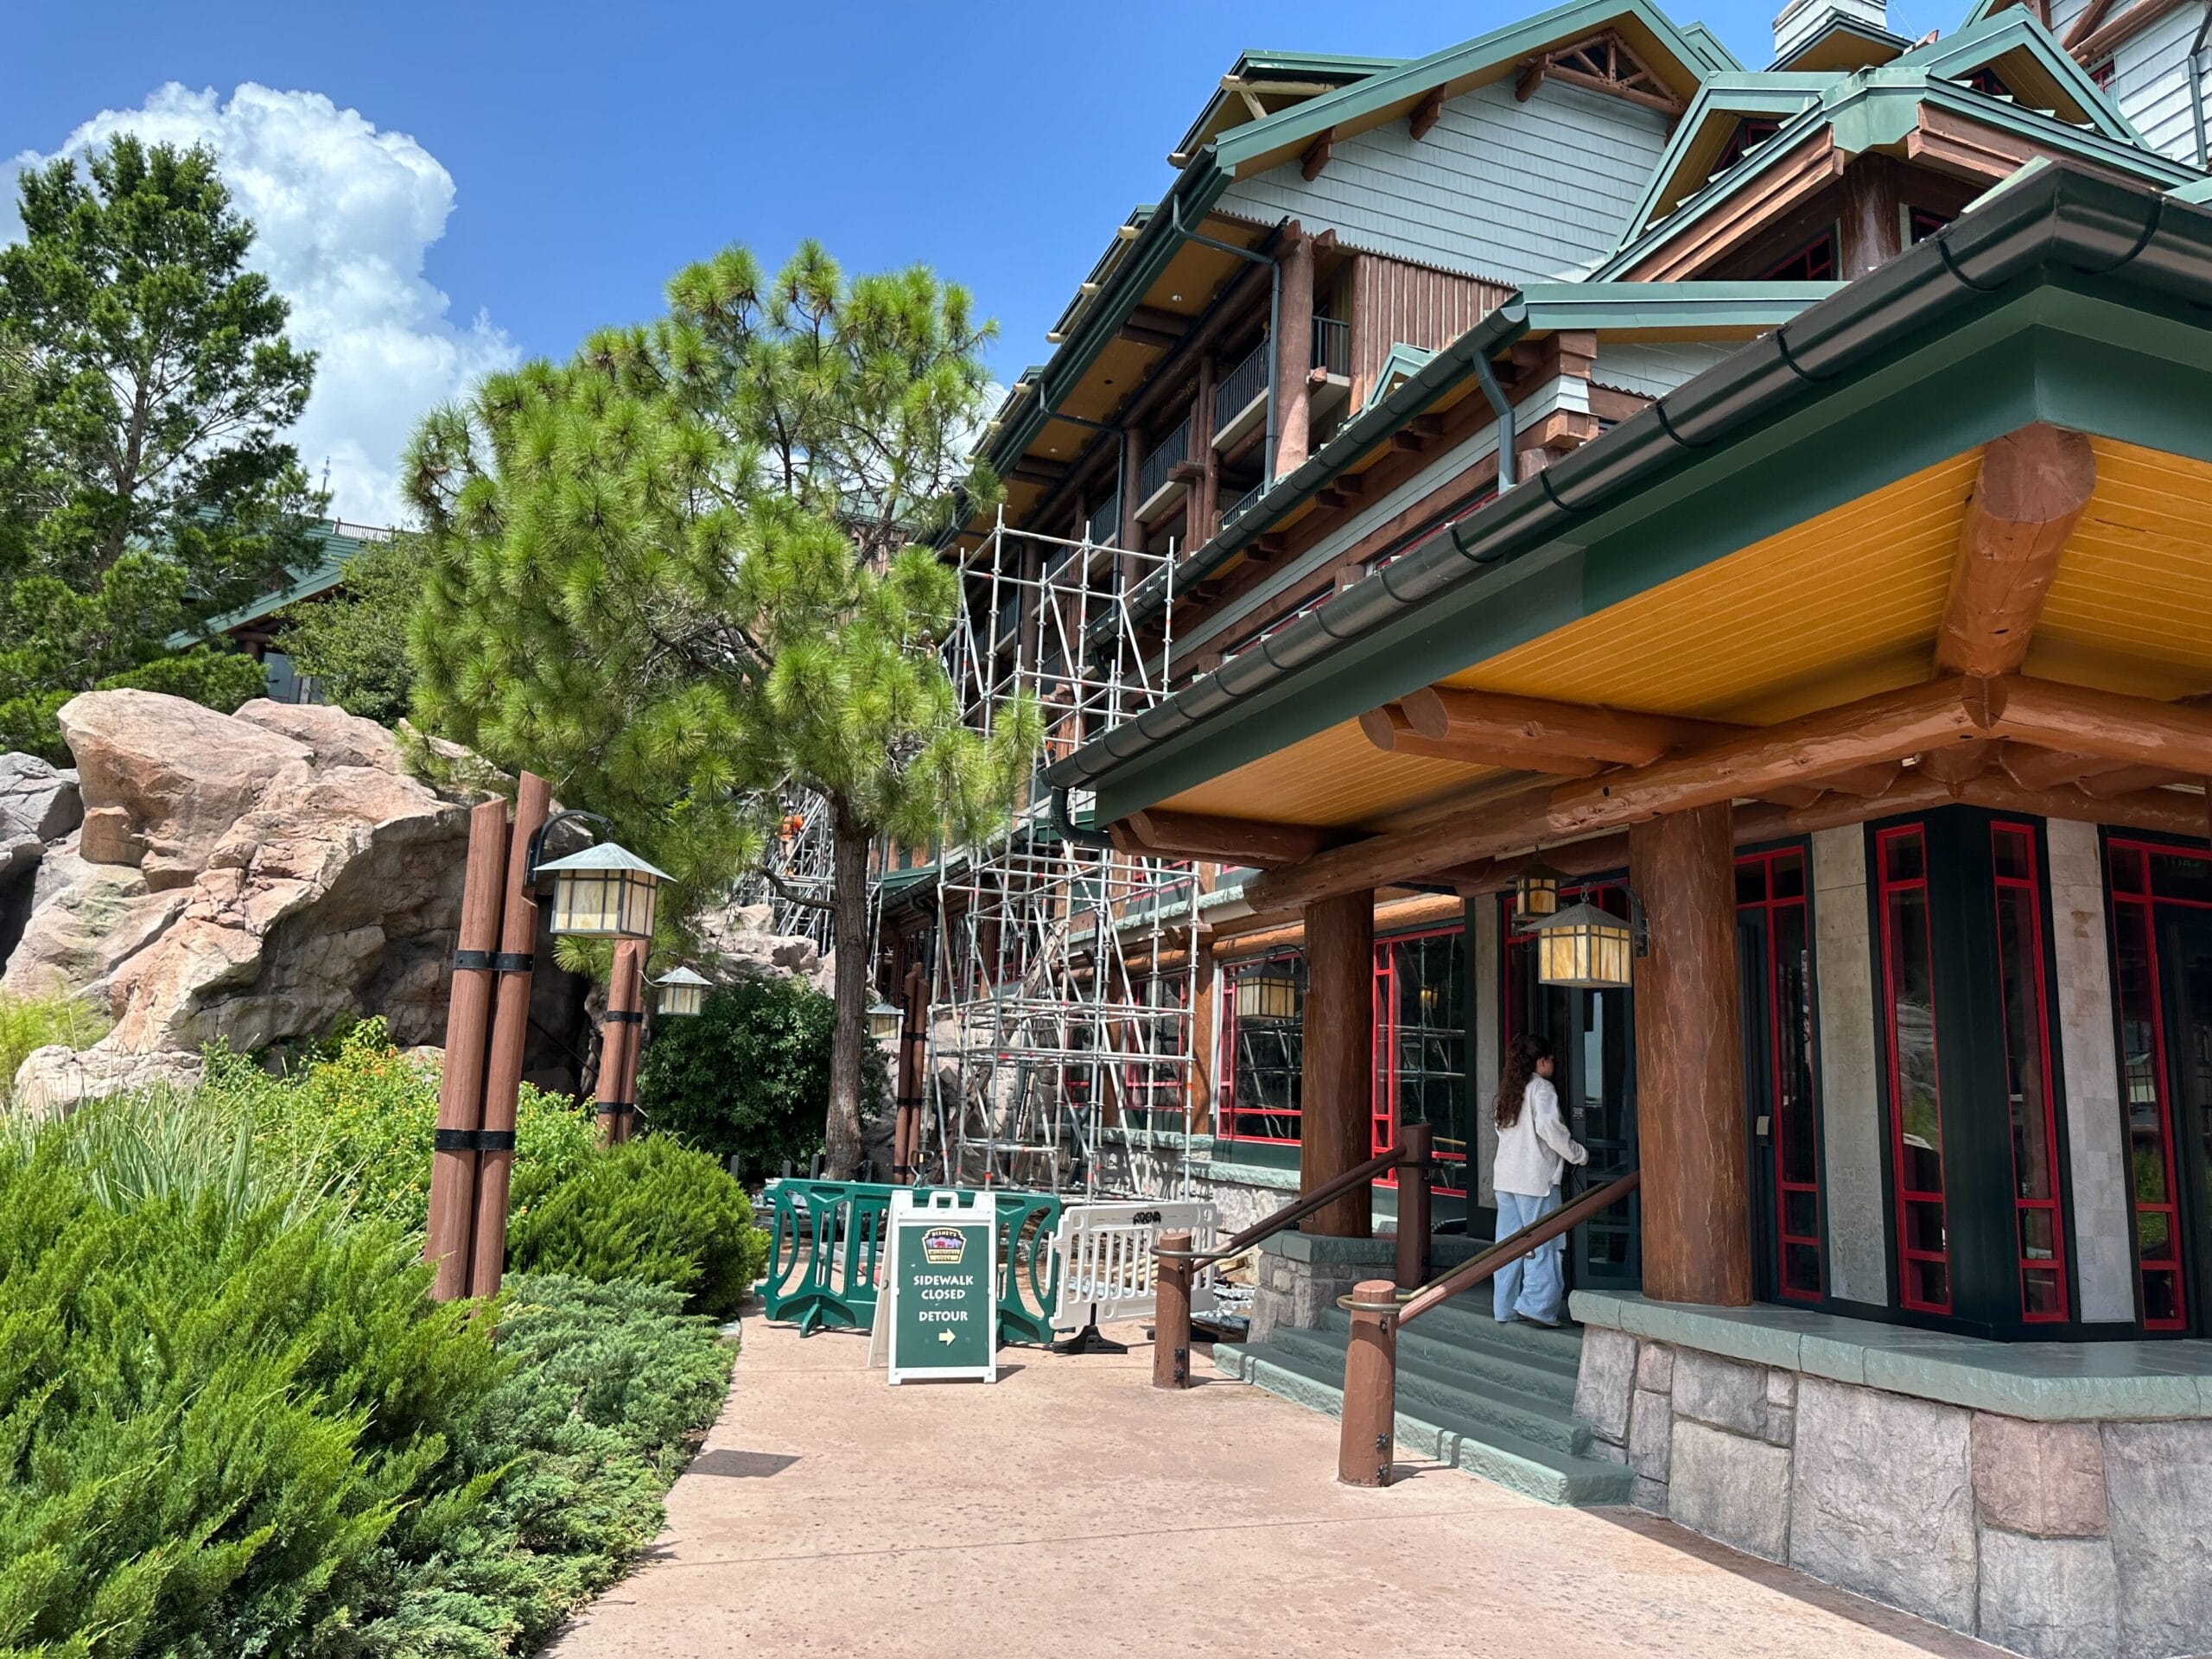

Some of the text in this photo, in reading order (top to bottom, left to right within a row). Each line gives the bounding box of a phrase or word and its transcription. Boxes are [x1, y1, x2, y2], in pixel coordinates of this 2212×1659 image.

[913, 1274, 974, 1286] SIDEWALK
[921, 1289, 966, 1300] CLOSED
[918, 1311, 969, 1322] DETOUR
